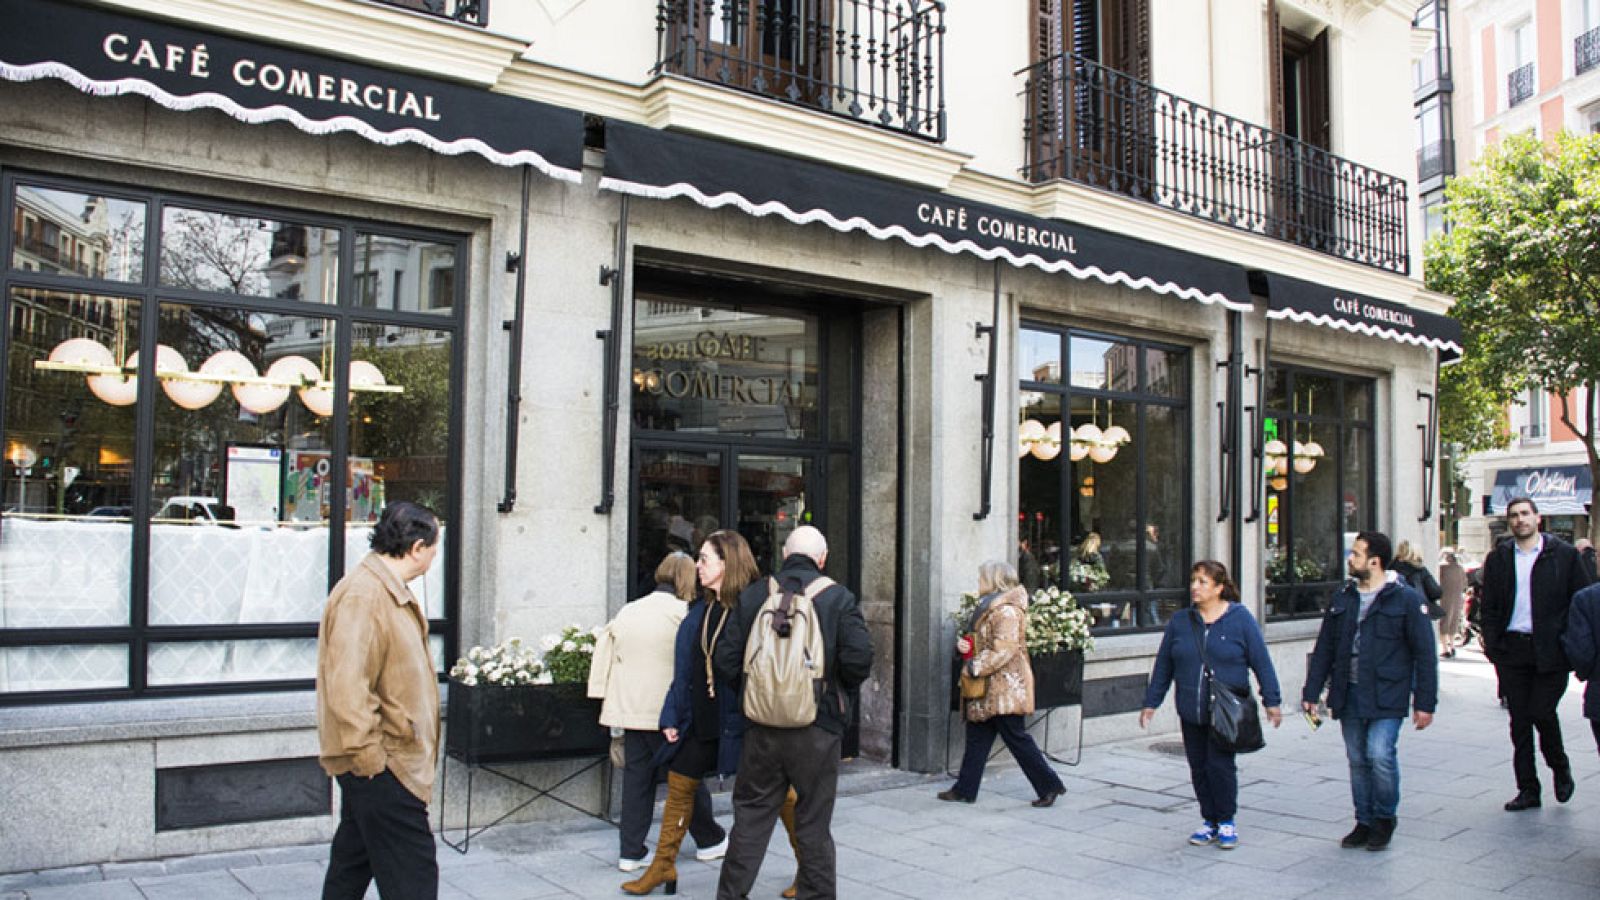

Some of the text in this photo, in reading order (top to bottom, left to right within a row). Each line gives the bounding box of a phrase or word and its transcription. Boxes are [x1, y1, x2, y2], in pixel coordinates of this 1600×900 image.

[103, 33, 441, 121] CAFÉ COMERCIAL
[917, 203, 1077, 254] CAFÉ COMERCIAL
[1333, 297, 1415, 328] CAFÉ COMERCIAL
